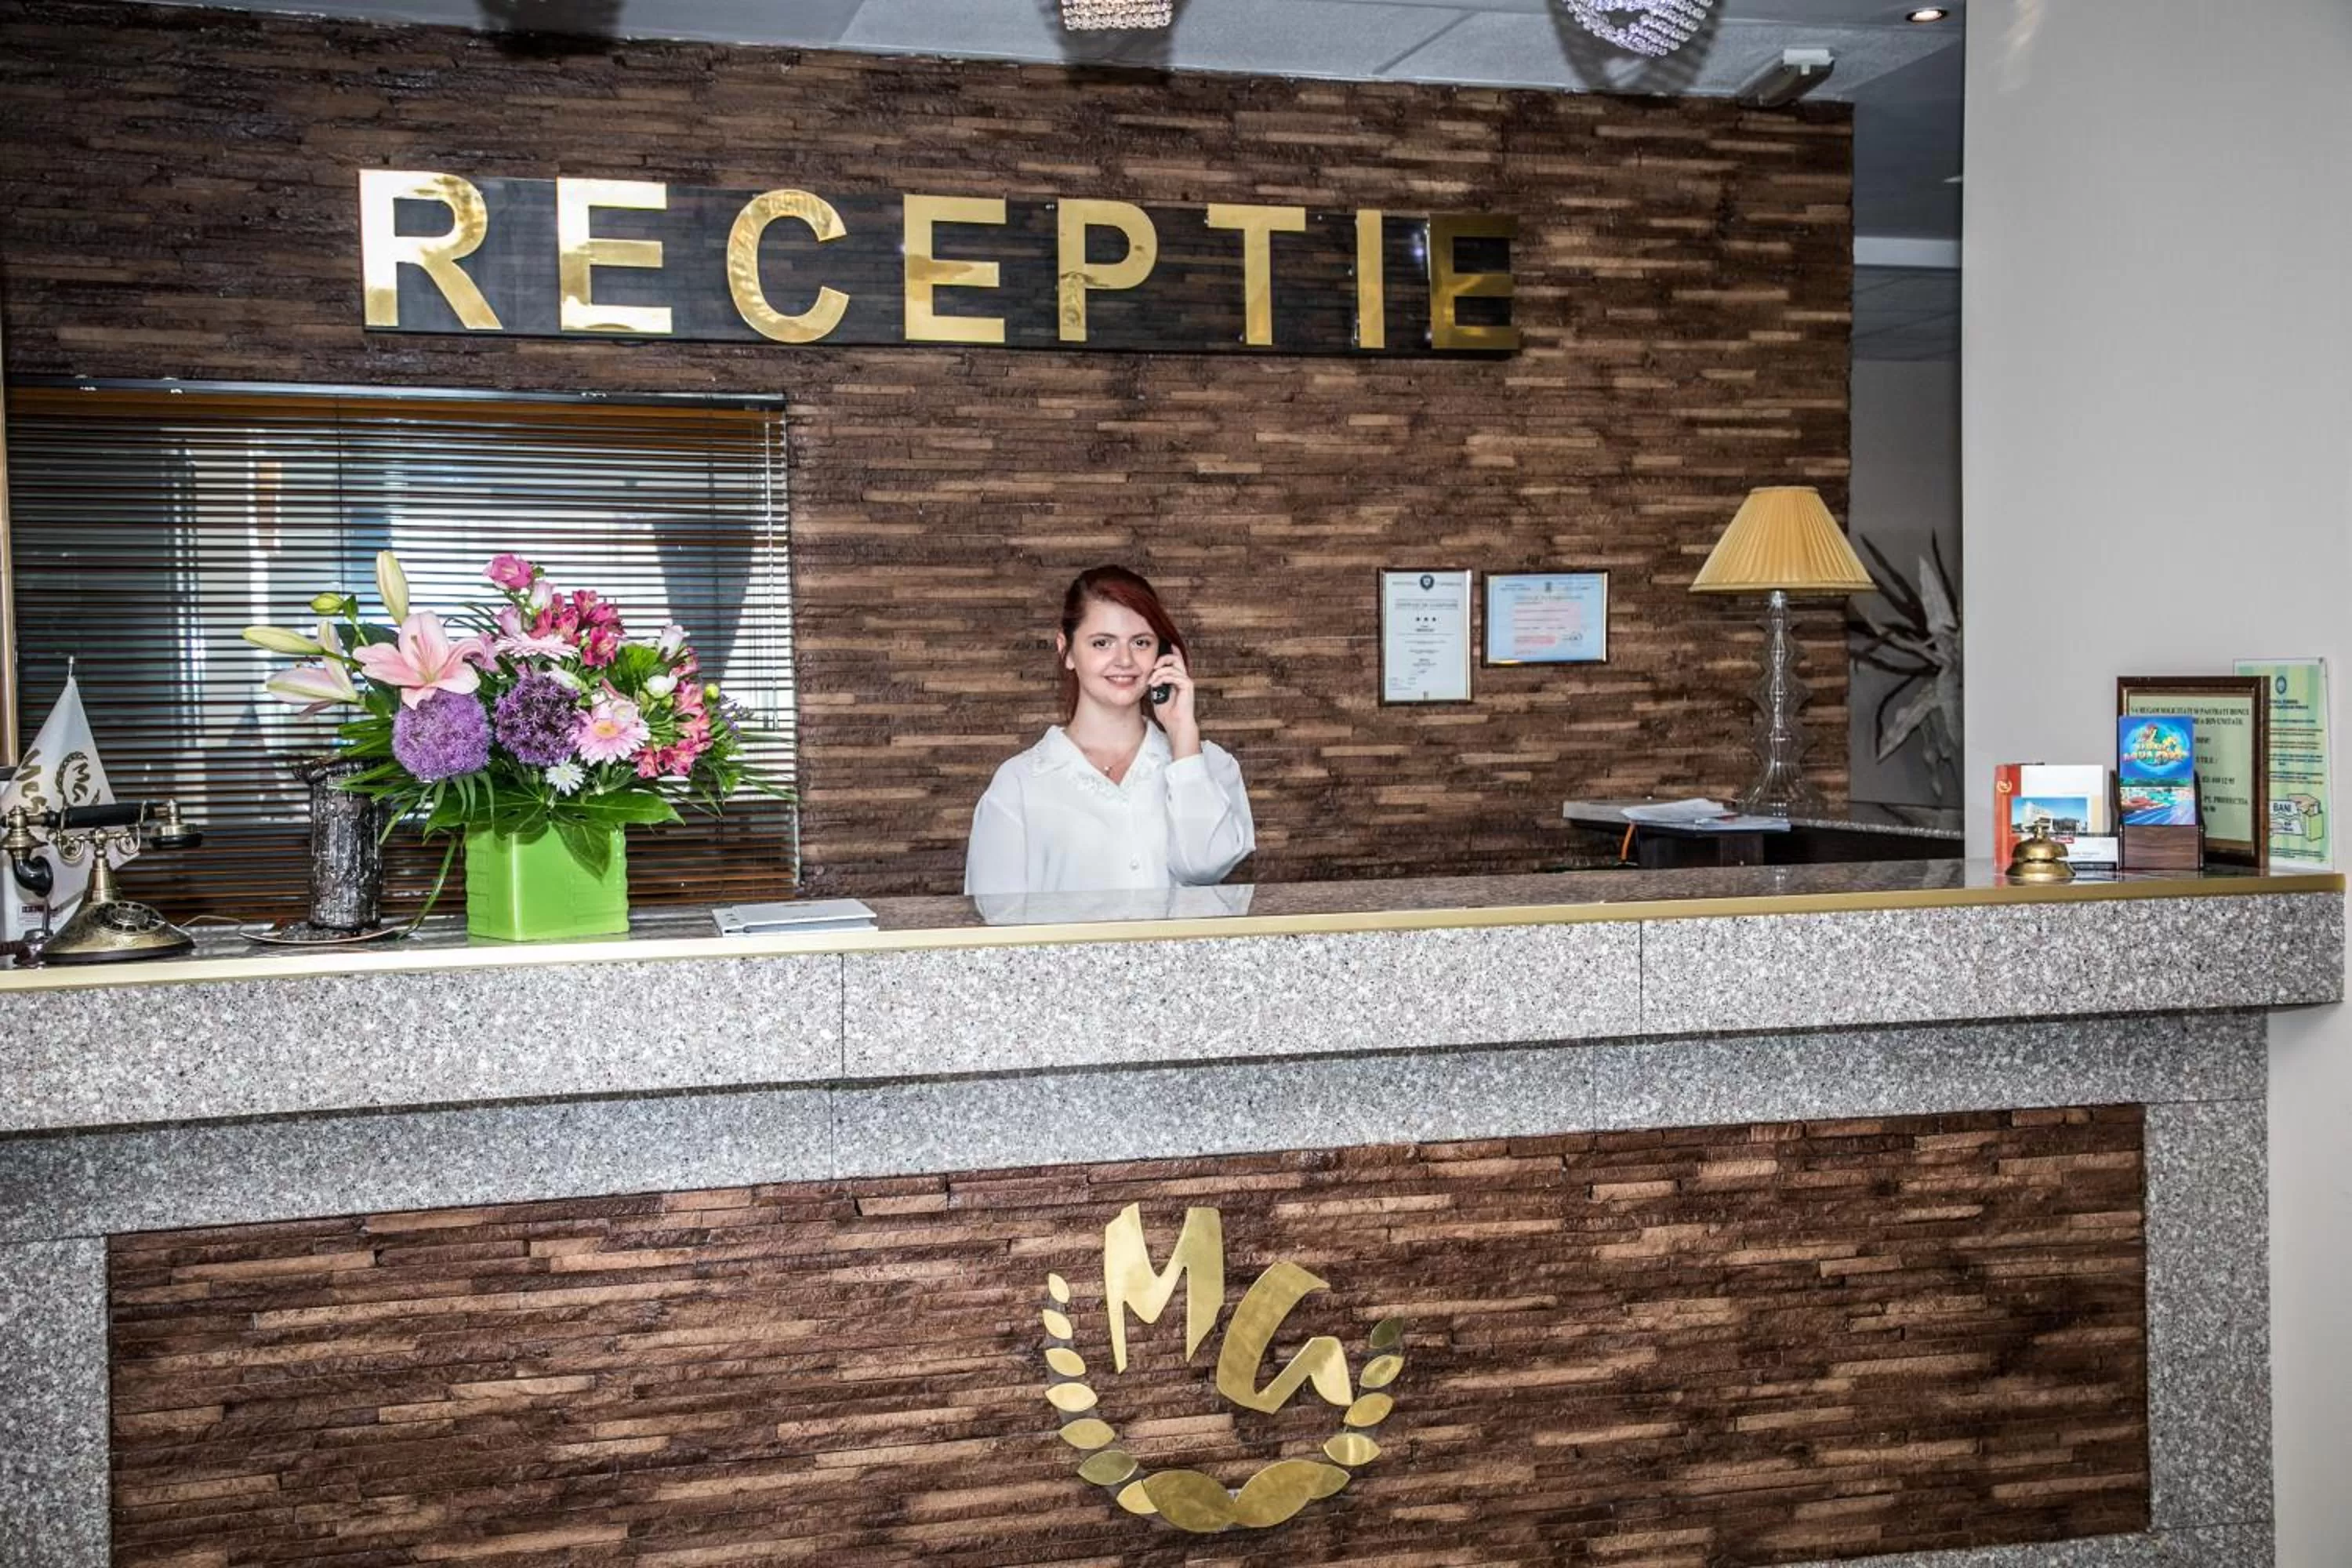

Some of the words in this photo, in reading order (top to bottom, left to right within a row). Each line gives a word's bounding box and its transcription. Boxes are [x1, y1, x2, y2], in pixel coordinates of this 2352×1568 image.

[358, 169, 1519, 350] RECEPTIE
[2273, 802, 2292, 812] BANI
[1103, 1202, 1353, 1414] MG
